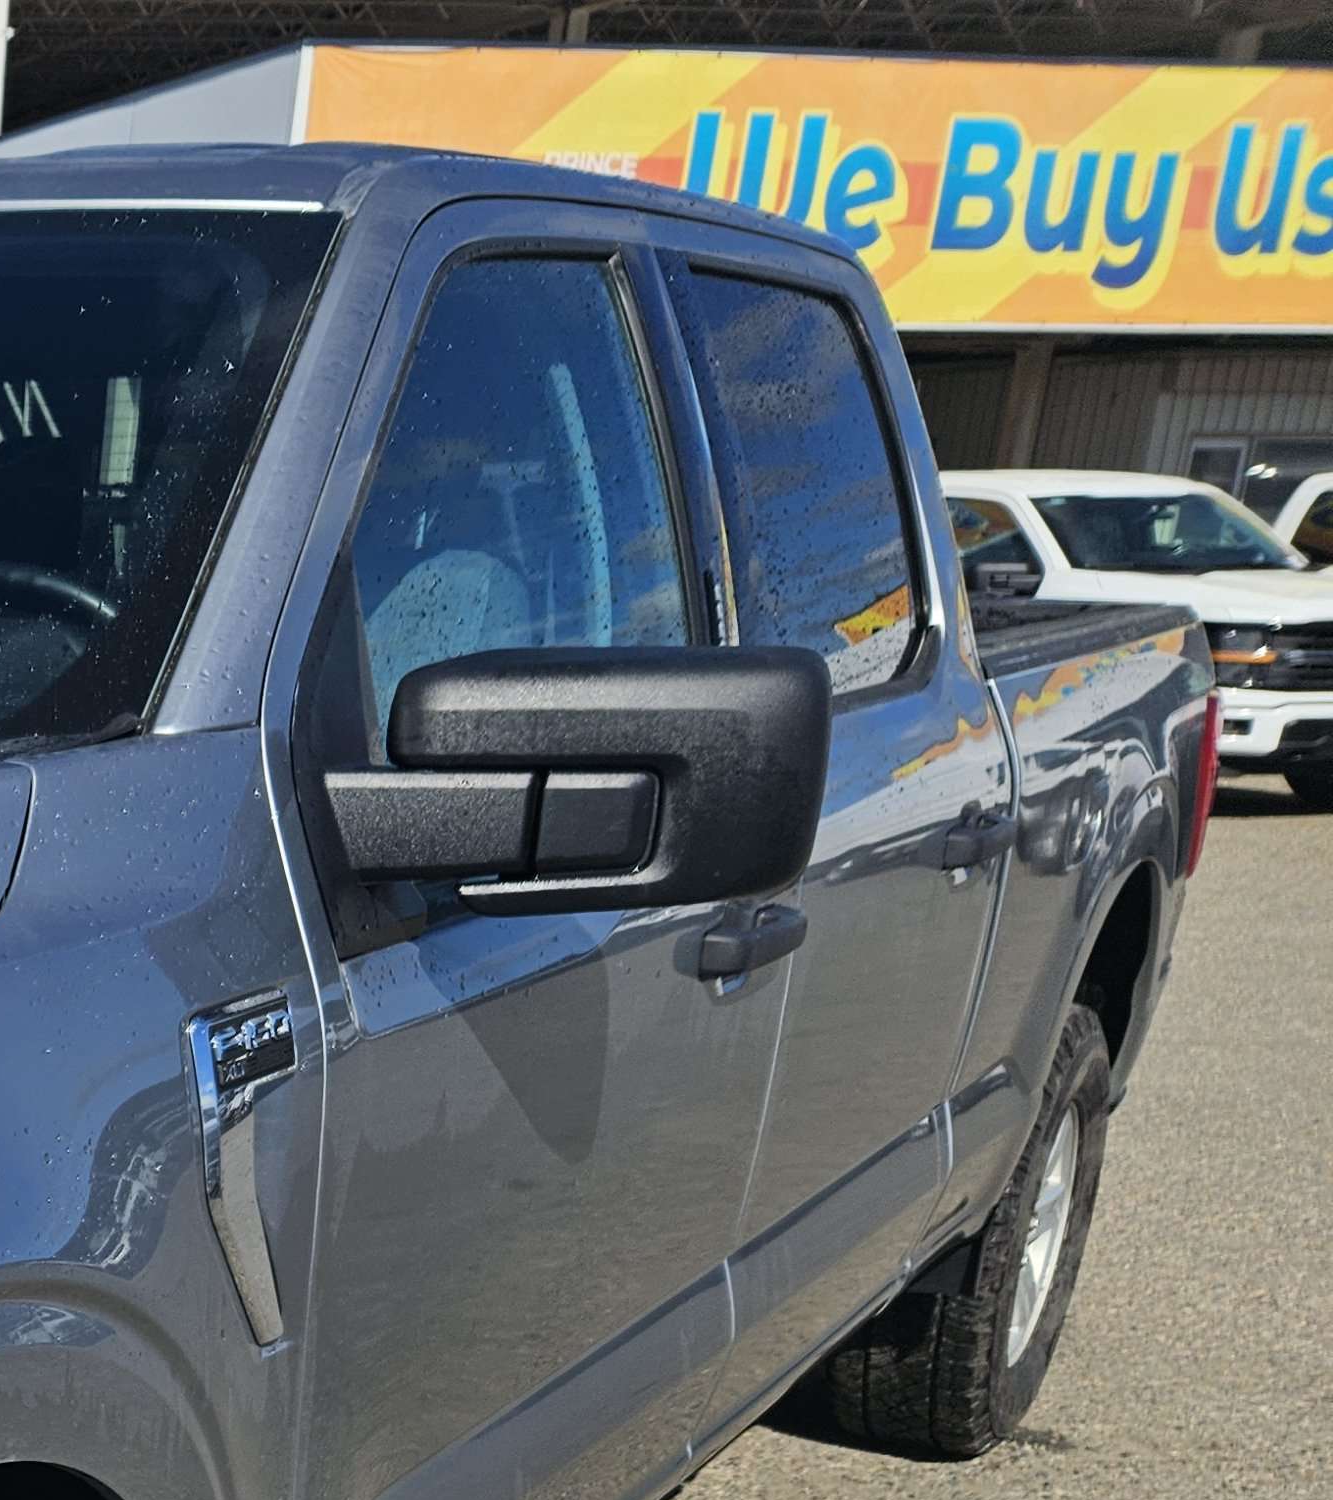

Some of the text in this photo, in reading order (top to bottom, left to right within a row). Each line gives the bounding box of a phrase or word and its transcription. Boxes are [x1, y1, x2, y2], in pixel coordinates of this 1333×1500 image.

[683, 110, 1333, 290] We Buy Us
